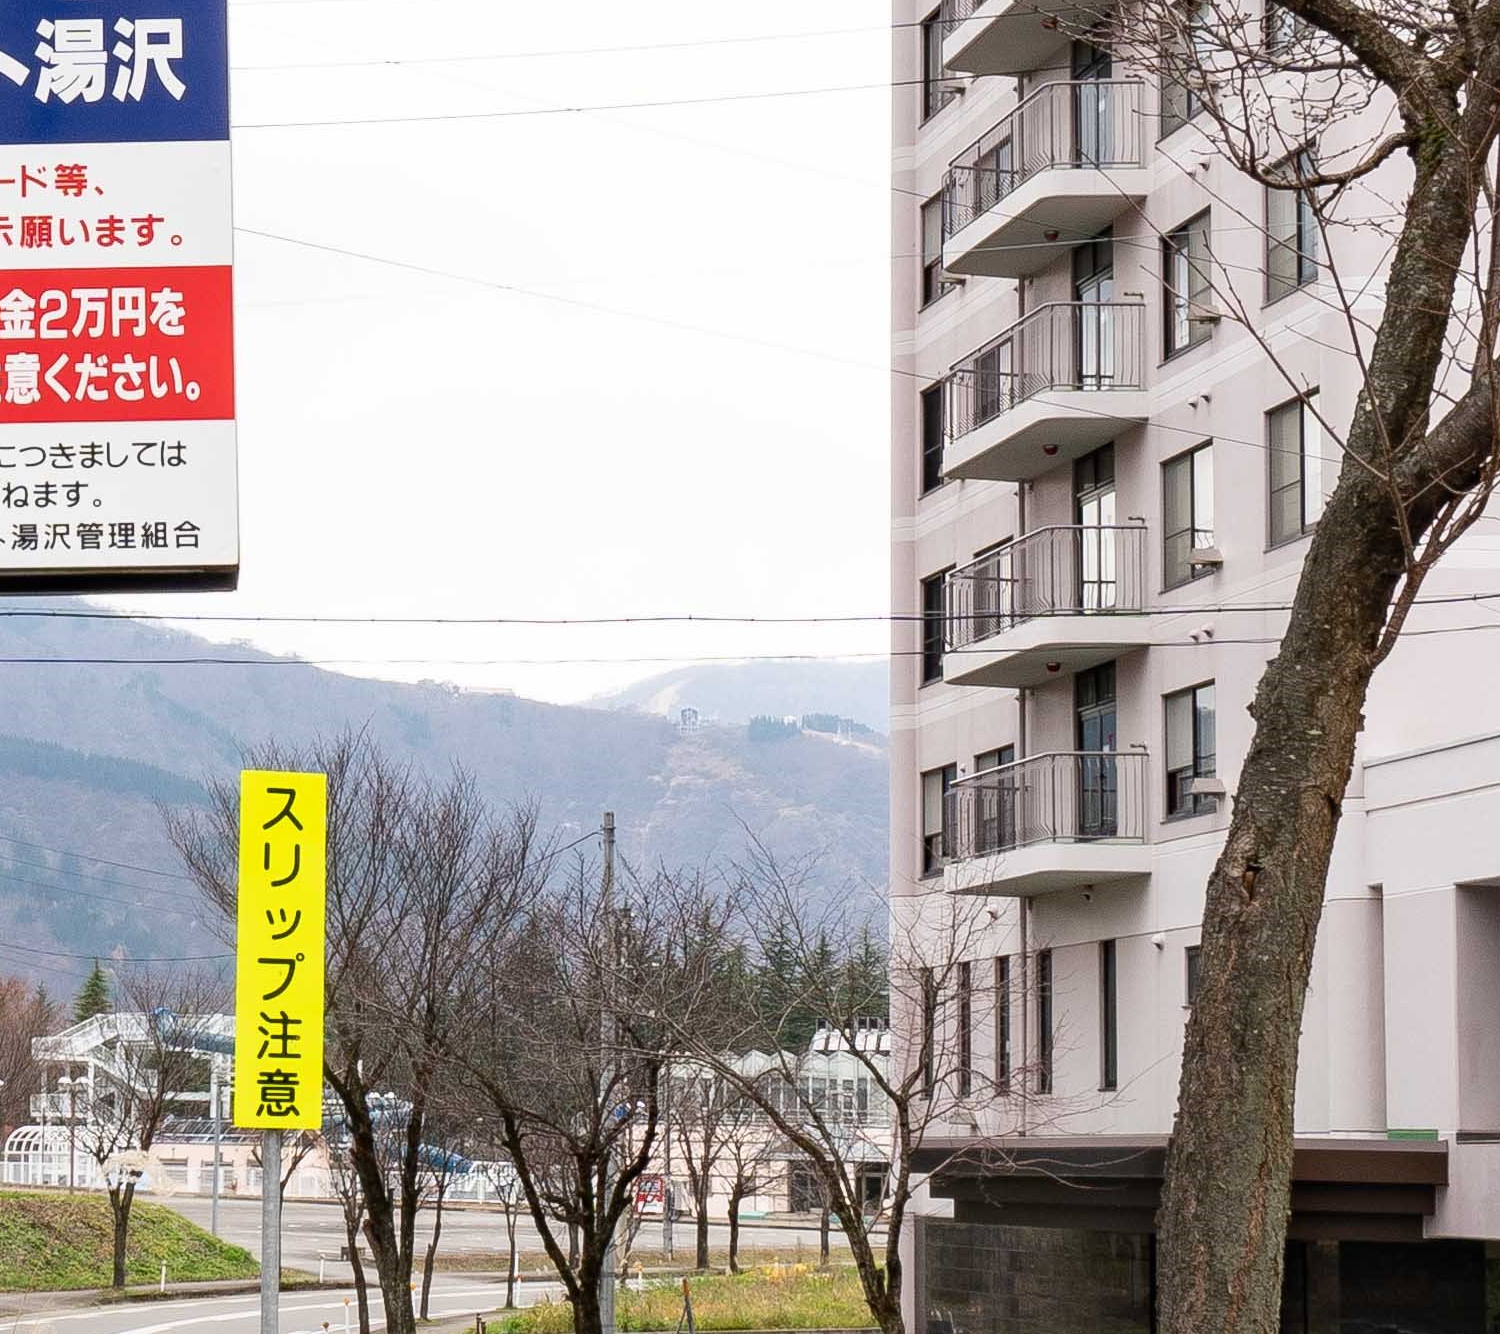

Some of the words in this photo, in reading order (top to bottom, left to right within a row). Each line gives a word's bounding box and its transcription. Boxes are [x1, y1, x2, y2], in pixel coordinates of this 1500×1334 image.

[255, 787, 305, 1117] スリップ注意
